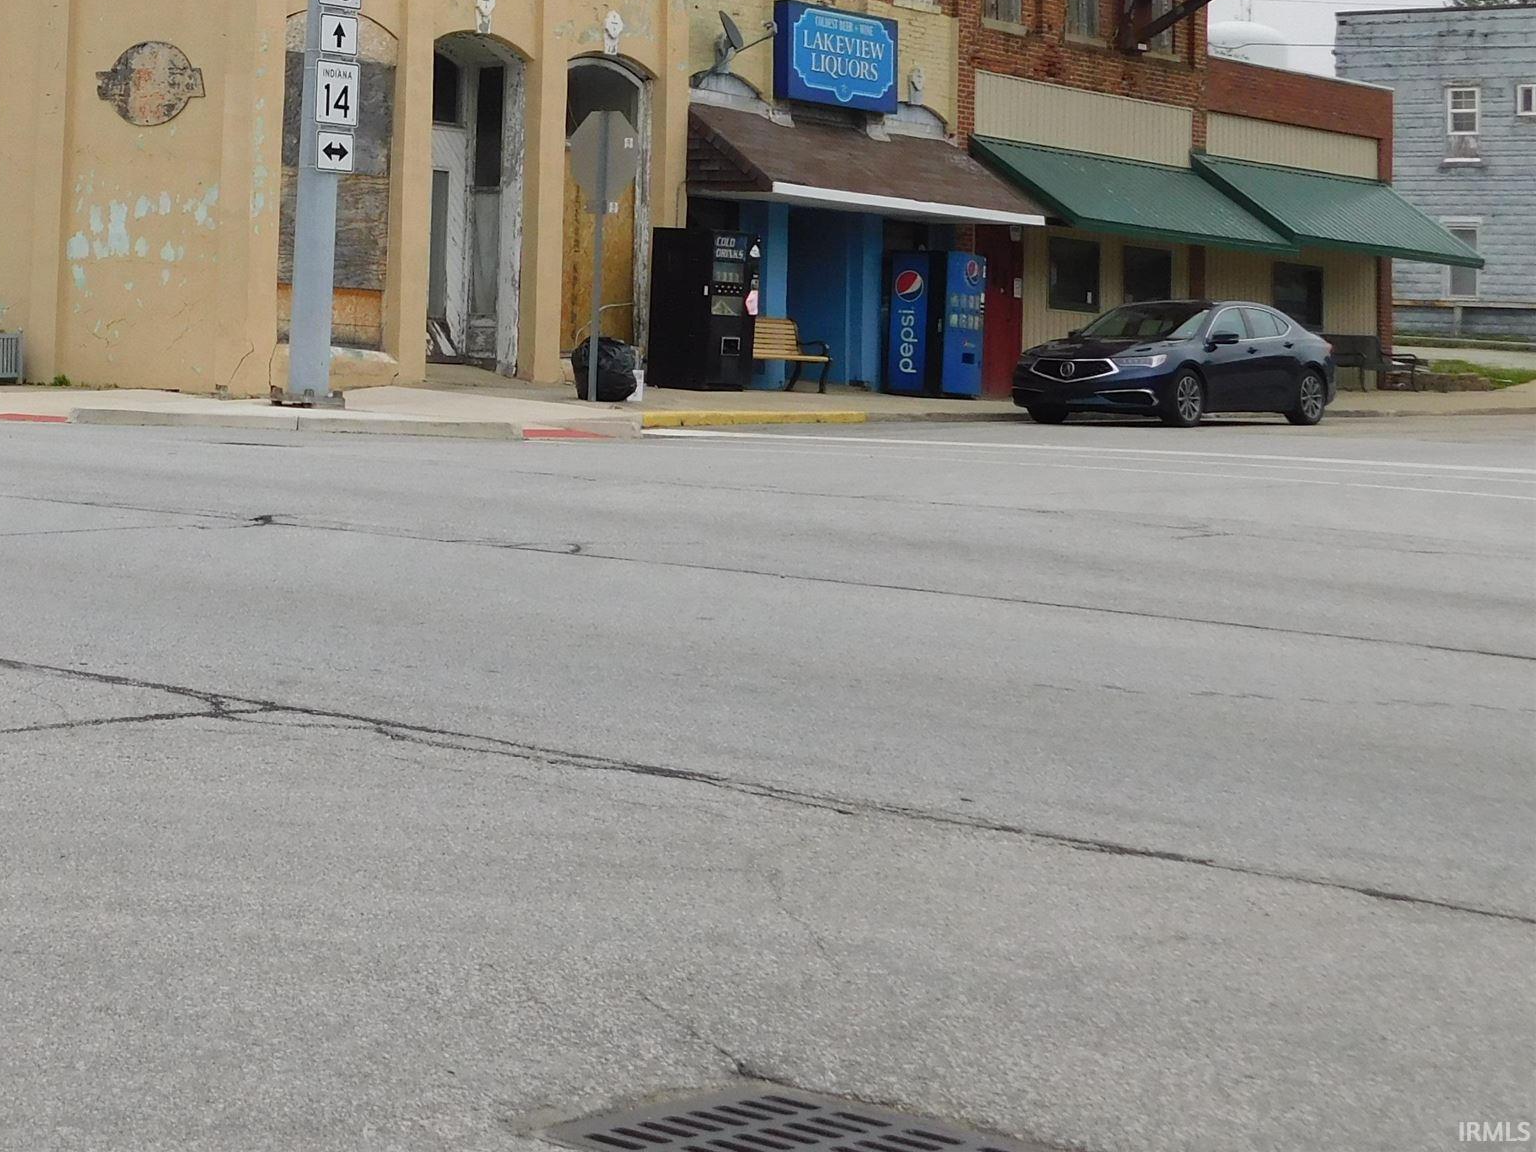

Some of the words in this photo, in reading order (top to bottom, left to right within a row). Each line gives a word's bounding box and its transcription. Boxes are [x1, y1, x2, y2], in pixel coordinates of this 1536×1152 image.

[803, 29, 885, 61] LAKEVIEW
[322, 68, 353, 80] INDIANA
[811, 52, 878, 82] LIQUORS
[324, 83, 351, 119] 14
[715, 248, 744, 260] DRINKS
[716, 236, 736, 248] COLD
[898, 309, 919, 374] pepsi
